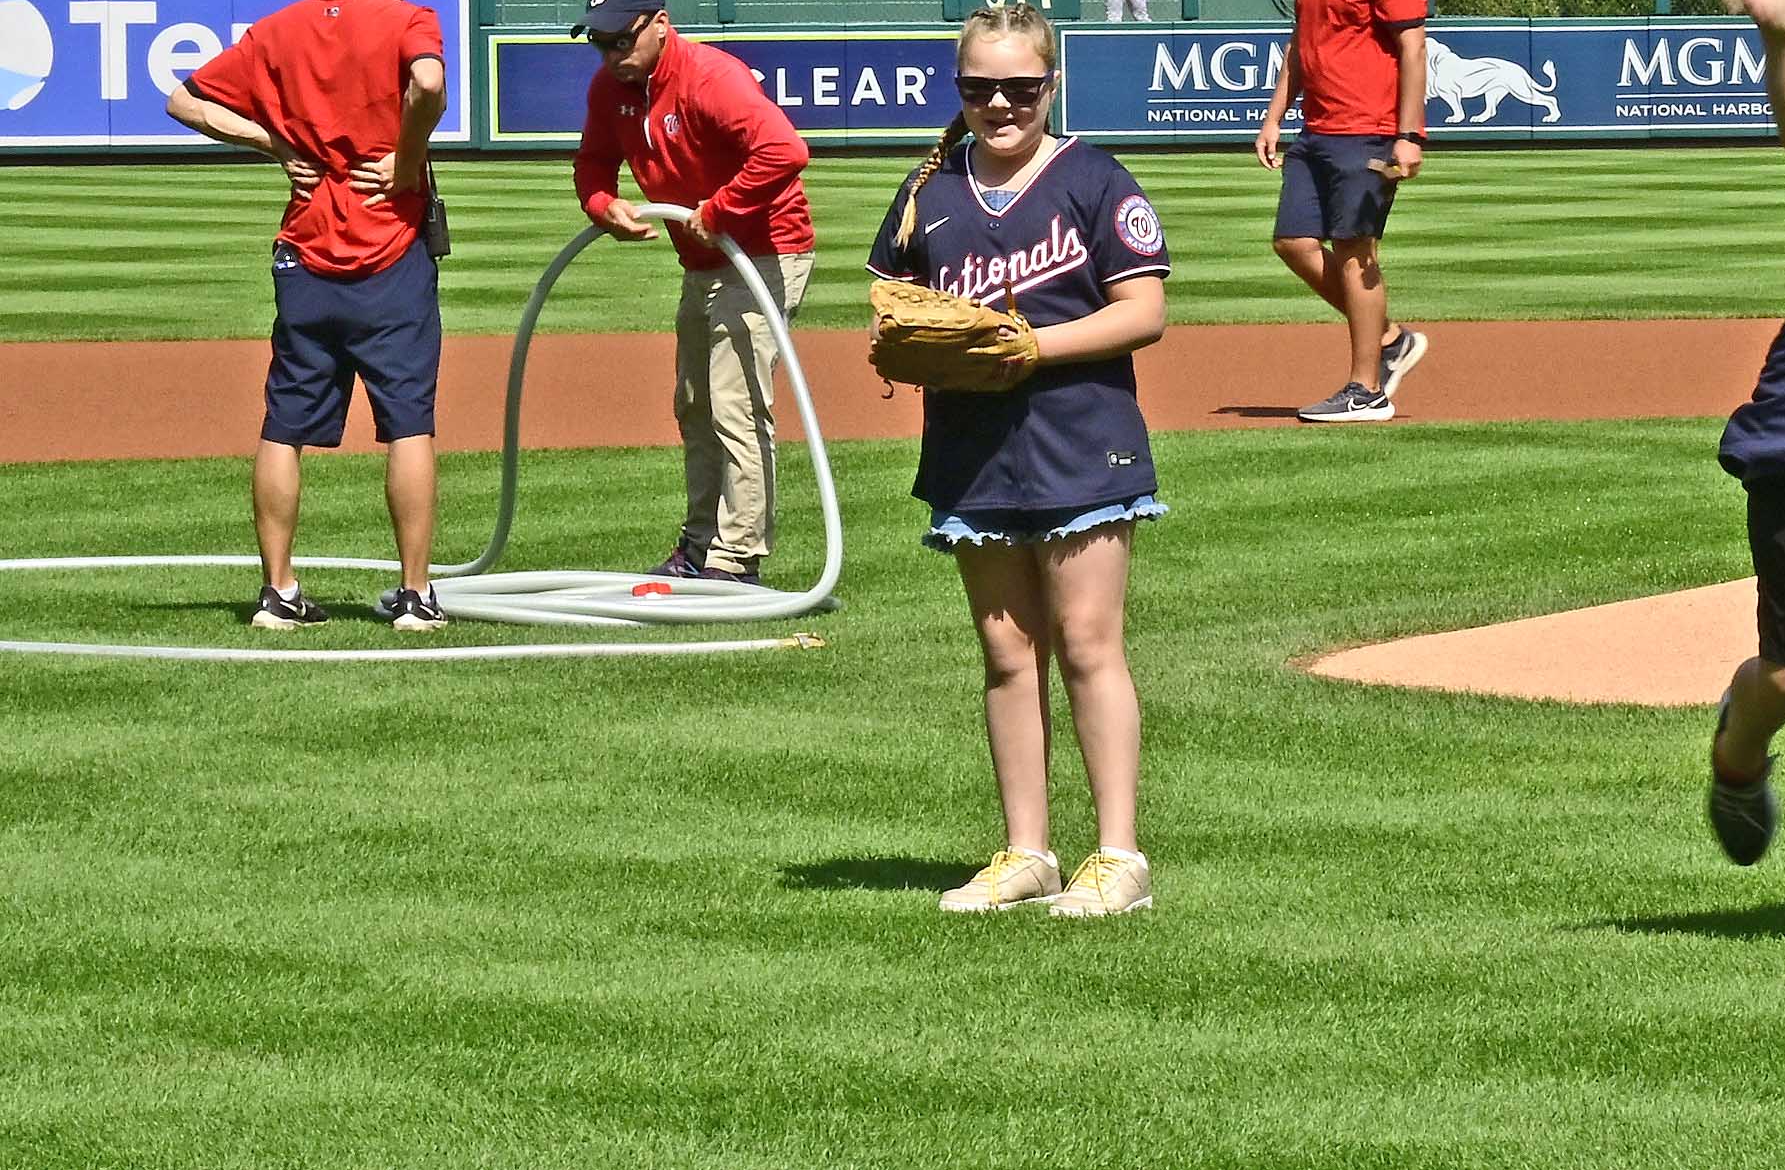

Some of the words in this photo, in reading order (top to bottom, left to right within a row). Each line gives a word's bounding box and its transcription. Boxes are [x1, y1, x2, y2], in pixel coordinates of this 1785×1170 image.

[69, 0, 254, 100] Te
[750, 66, 928, 107] LEAR
[1147, 109, 1241, 123] NATIONAL
[1246, 108, 1304, 122] HAB
[1616, 104, 1708, 118] NATIONAL
[1712, 102, 1775, 116] HARBO
